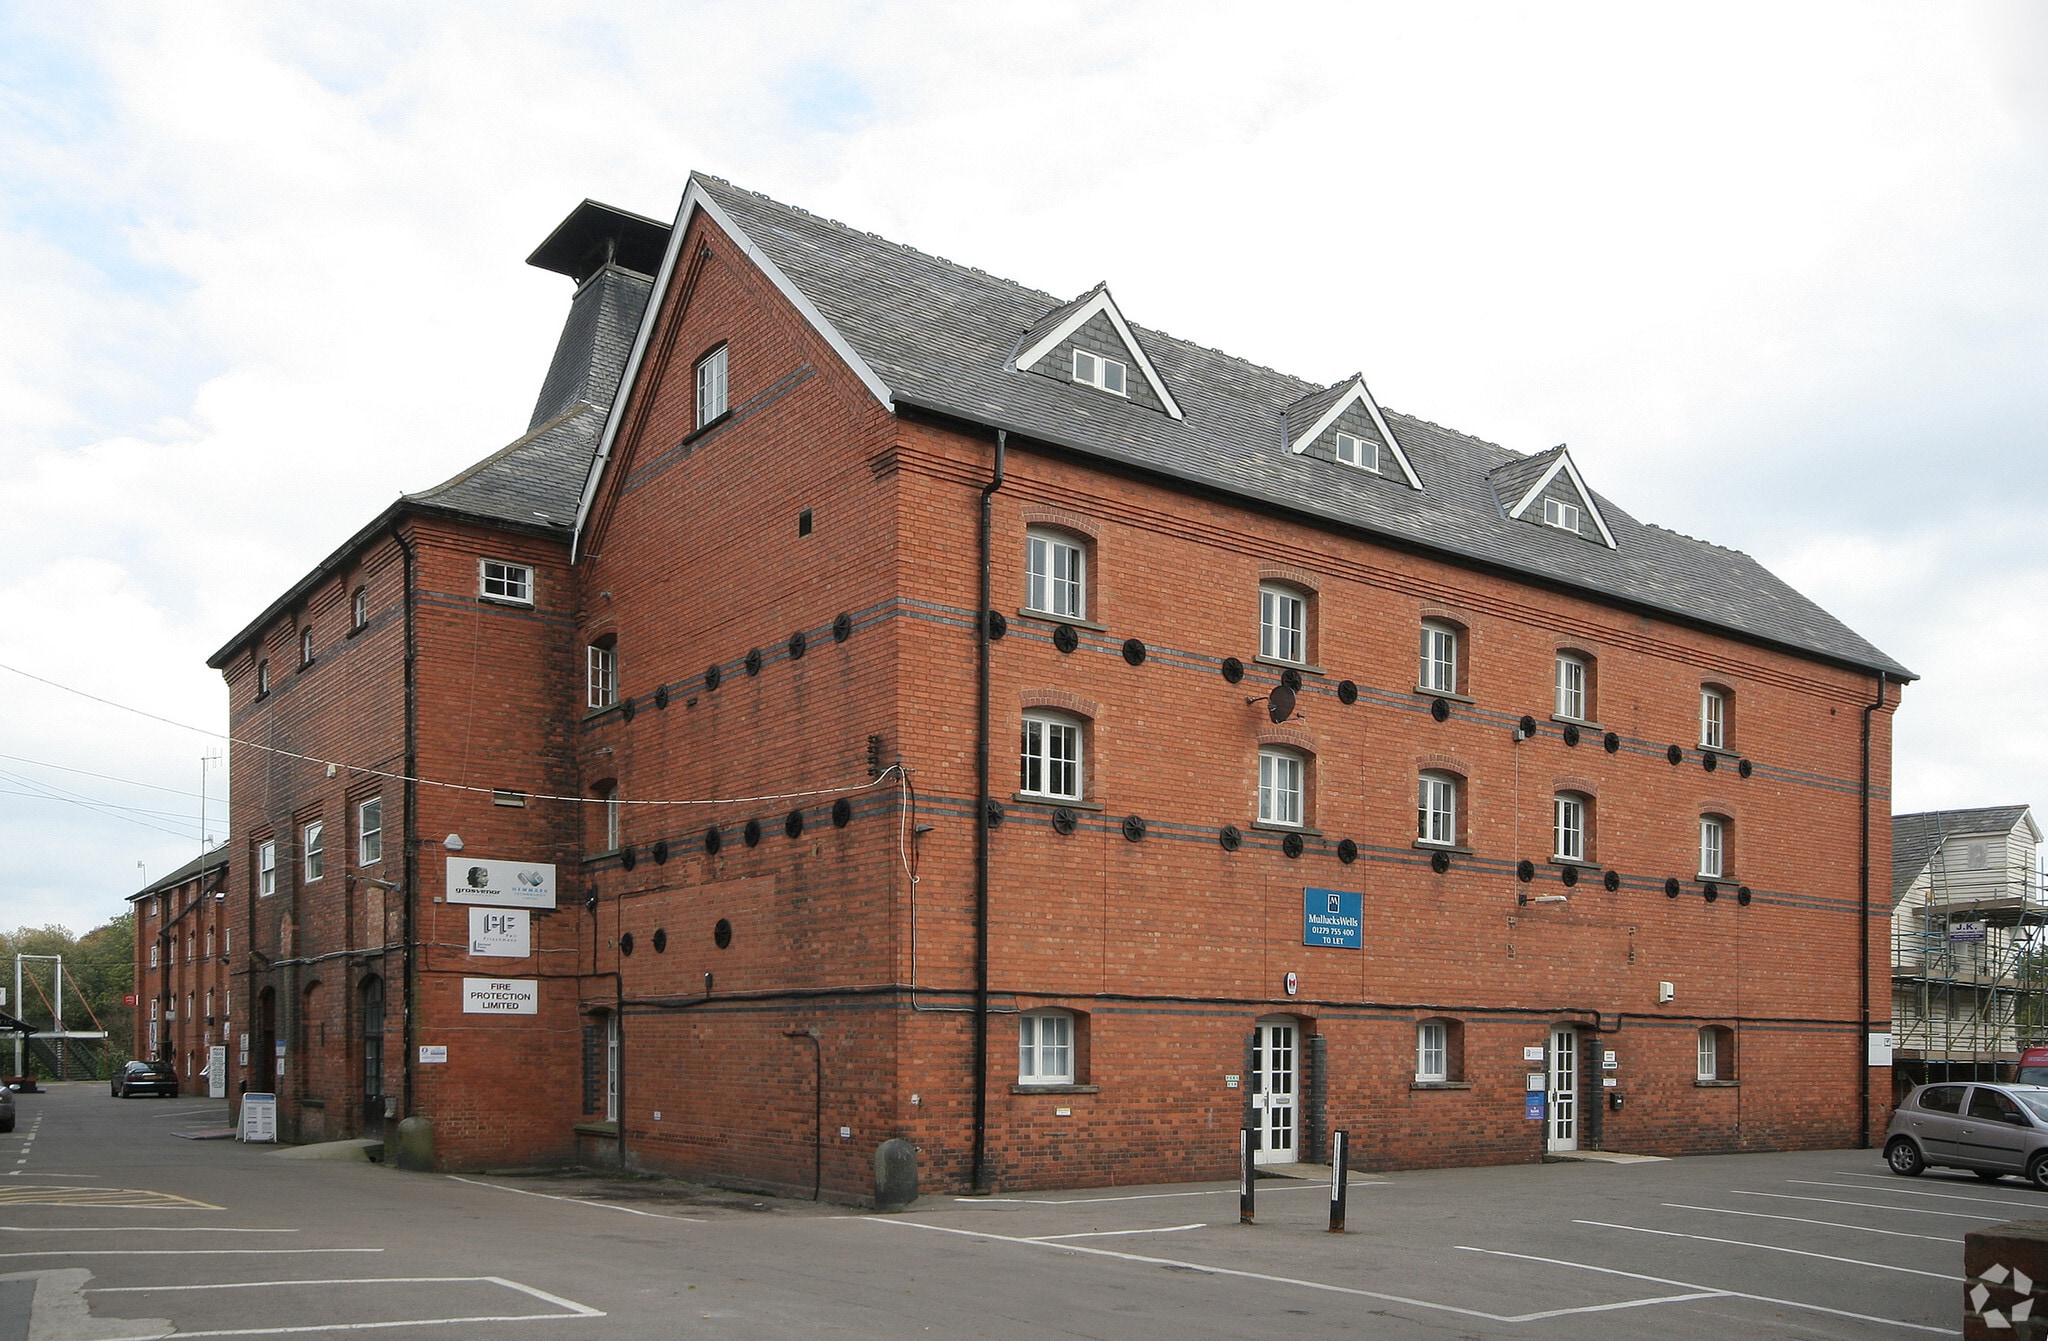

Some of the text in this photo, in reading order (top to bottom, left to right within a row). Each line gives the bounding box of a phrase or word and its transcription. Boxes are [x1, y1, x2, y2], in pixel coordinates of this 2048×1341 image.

[455, 887, 501, 895] grosvenor
[1312, 926, 1354, 937] 01279 755 400
[1322, 936, 1344, 945] TO LET
[490, 983, 511, 991] FIRE
[470, 991, 531, 1001] PROTECTION
[482, 1001, 519, 1010] LIMITED
